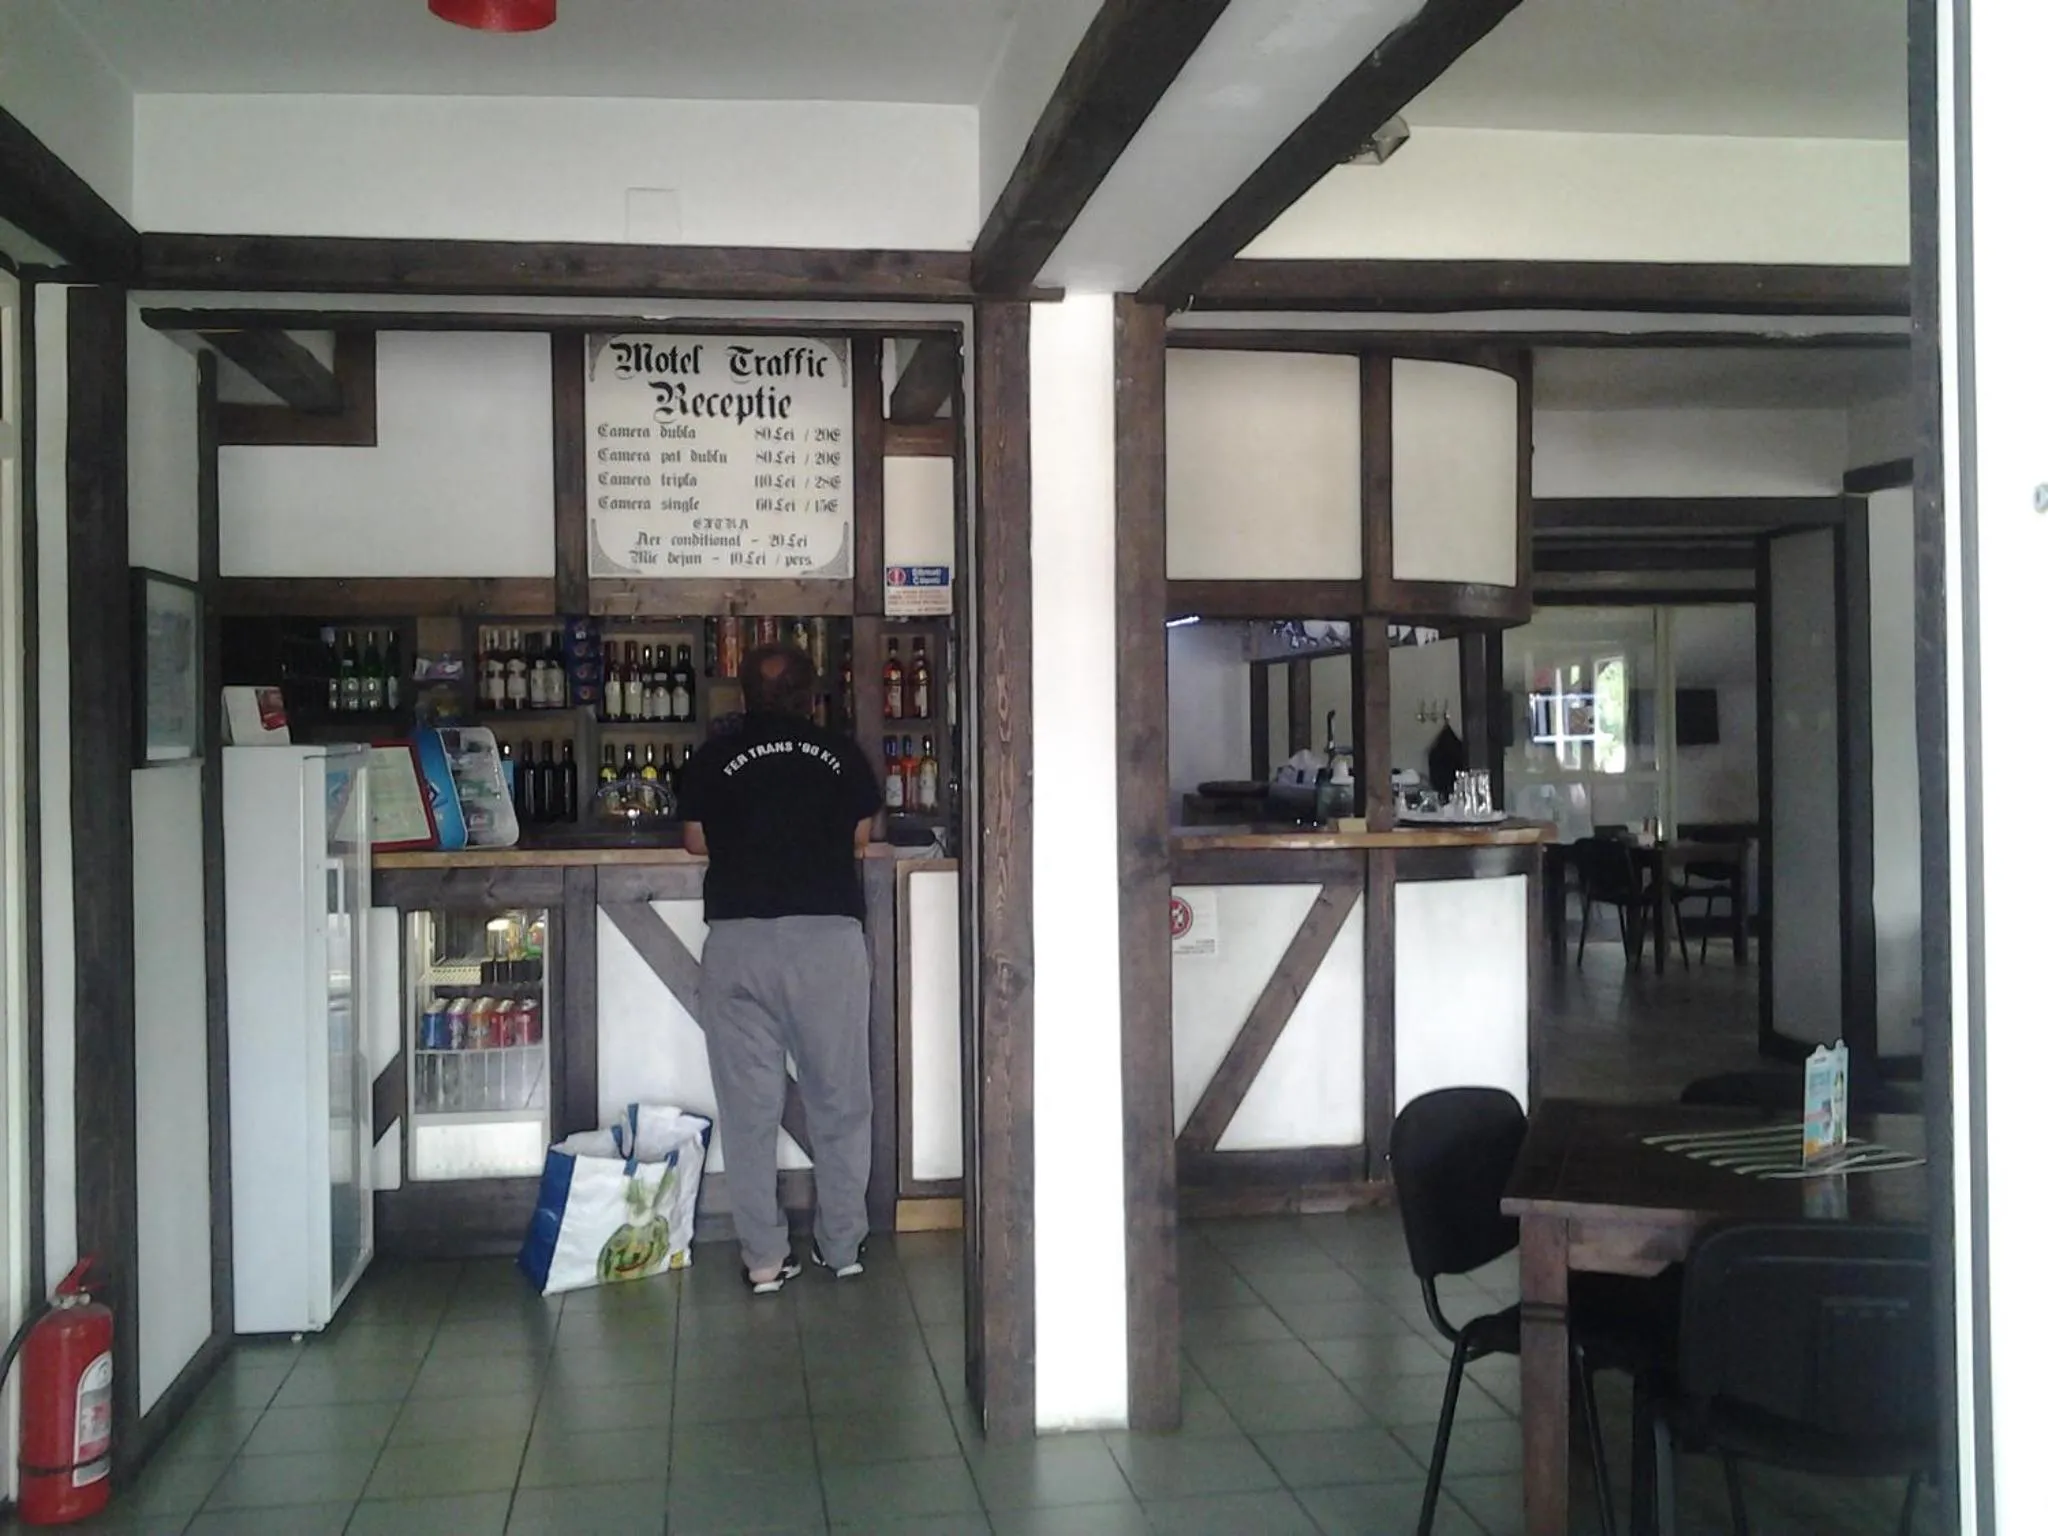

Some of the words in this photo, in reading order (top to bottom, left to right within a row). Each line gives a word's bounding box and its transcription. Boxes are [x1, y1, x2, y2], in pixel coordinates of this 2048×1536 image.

[609, 342, 703, 380] Motel
[726, 346, 828, 384] Traffic
[648, 381, 792, 425] Receptie
[597, 423, 651, 438] Camera
[660, 424, 696, 438] dubla
[597, 447, 651, 462] Camera
[661, 449, 681, 464] pat
[690, 449, 728, 463] dublu
[597, 471, 651, 486] Camera
[661, 472, 698, 488] tripla
[597, 495, 651, 510] Camera
[661, 496, 700, 512] single
[692, 518, 749, 530] EXTRA
[636, 531, 661, 546] Aer
[628, 550, 658, 565] Mic
[667, 551, 702, 567] dejun
[747, 741, 793, 759] TRANS
